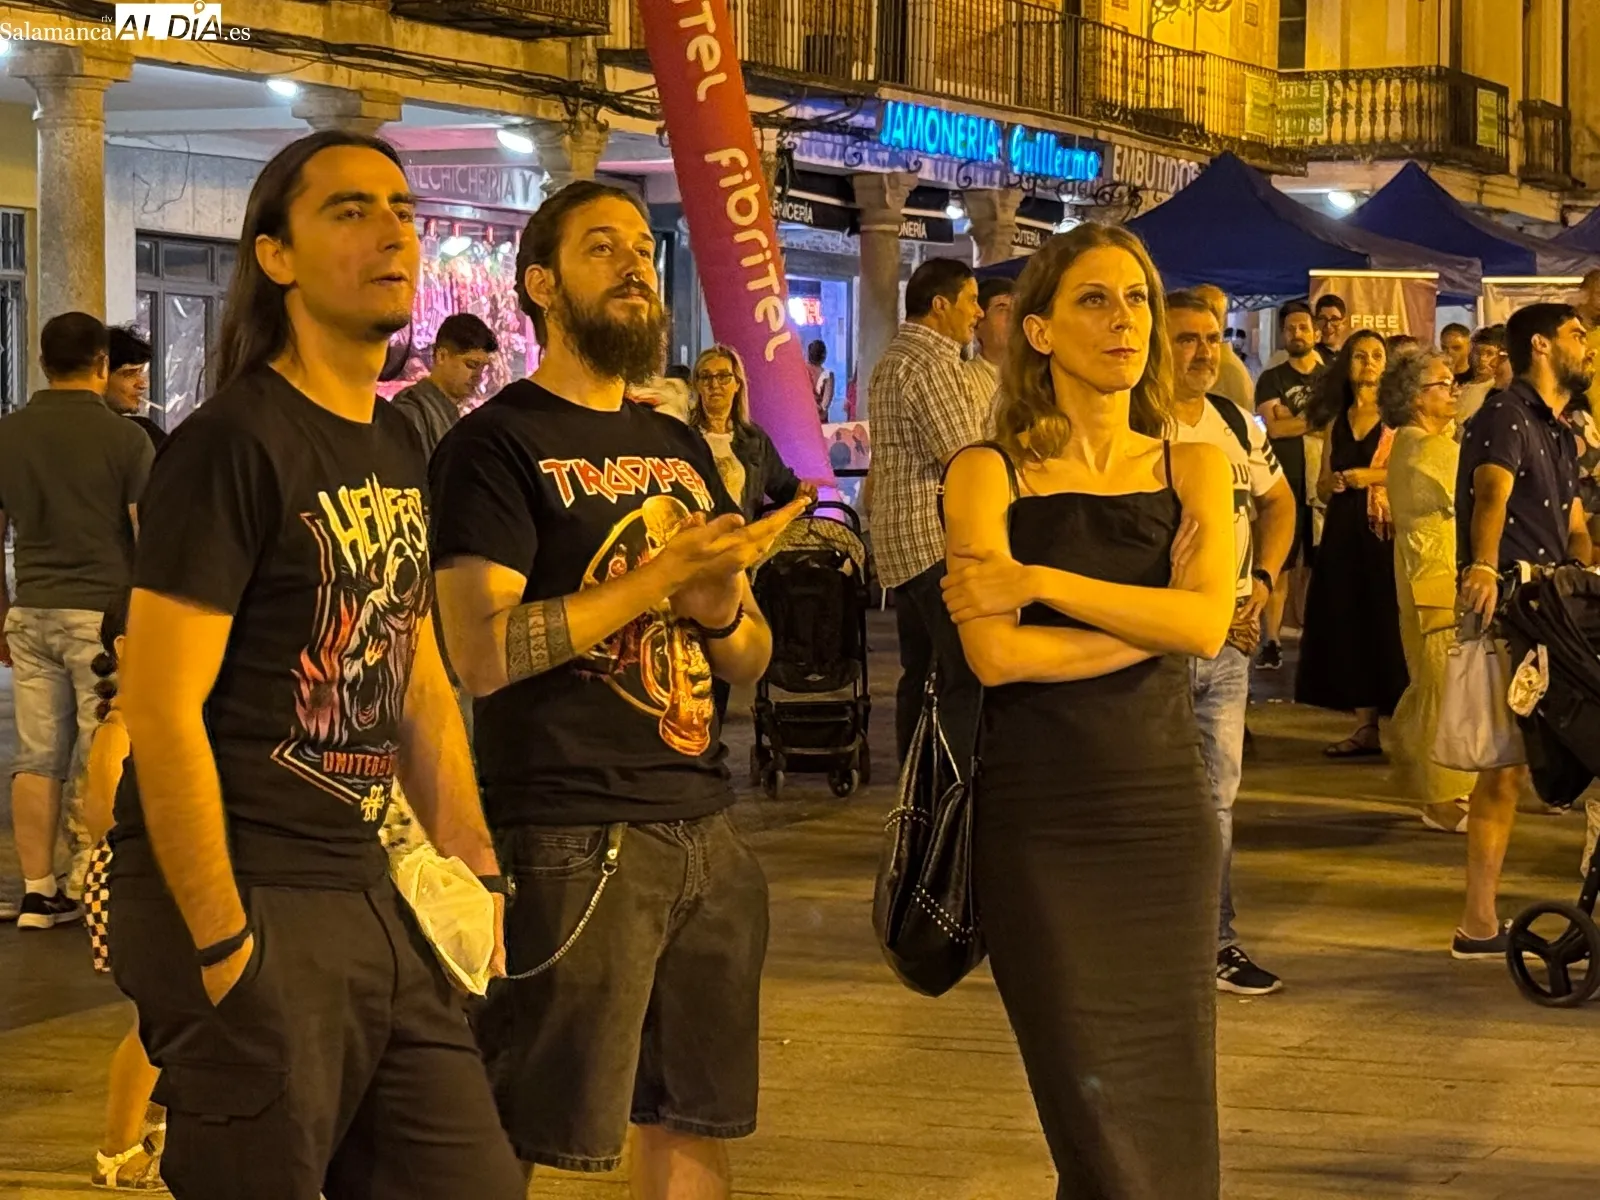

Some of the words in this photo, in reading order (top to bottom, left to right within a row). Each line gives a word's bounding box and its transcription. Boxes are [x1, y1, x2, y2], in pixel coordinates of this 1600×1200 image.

[879, 100, 1000, 163] JAMONERIA
[1009, 124, 1101, 181] Guillermo
[1350, 314, 1400, 329] FREE
